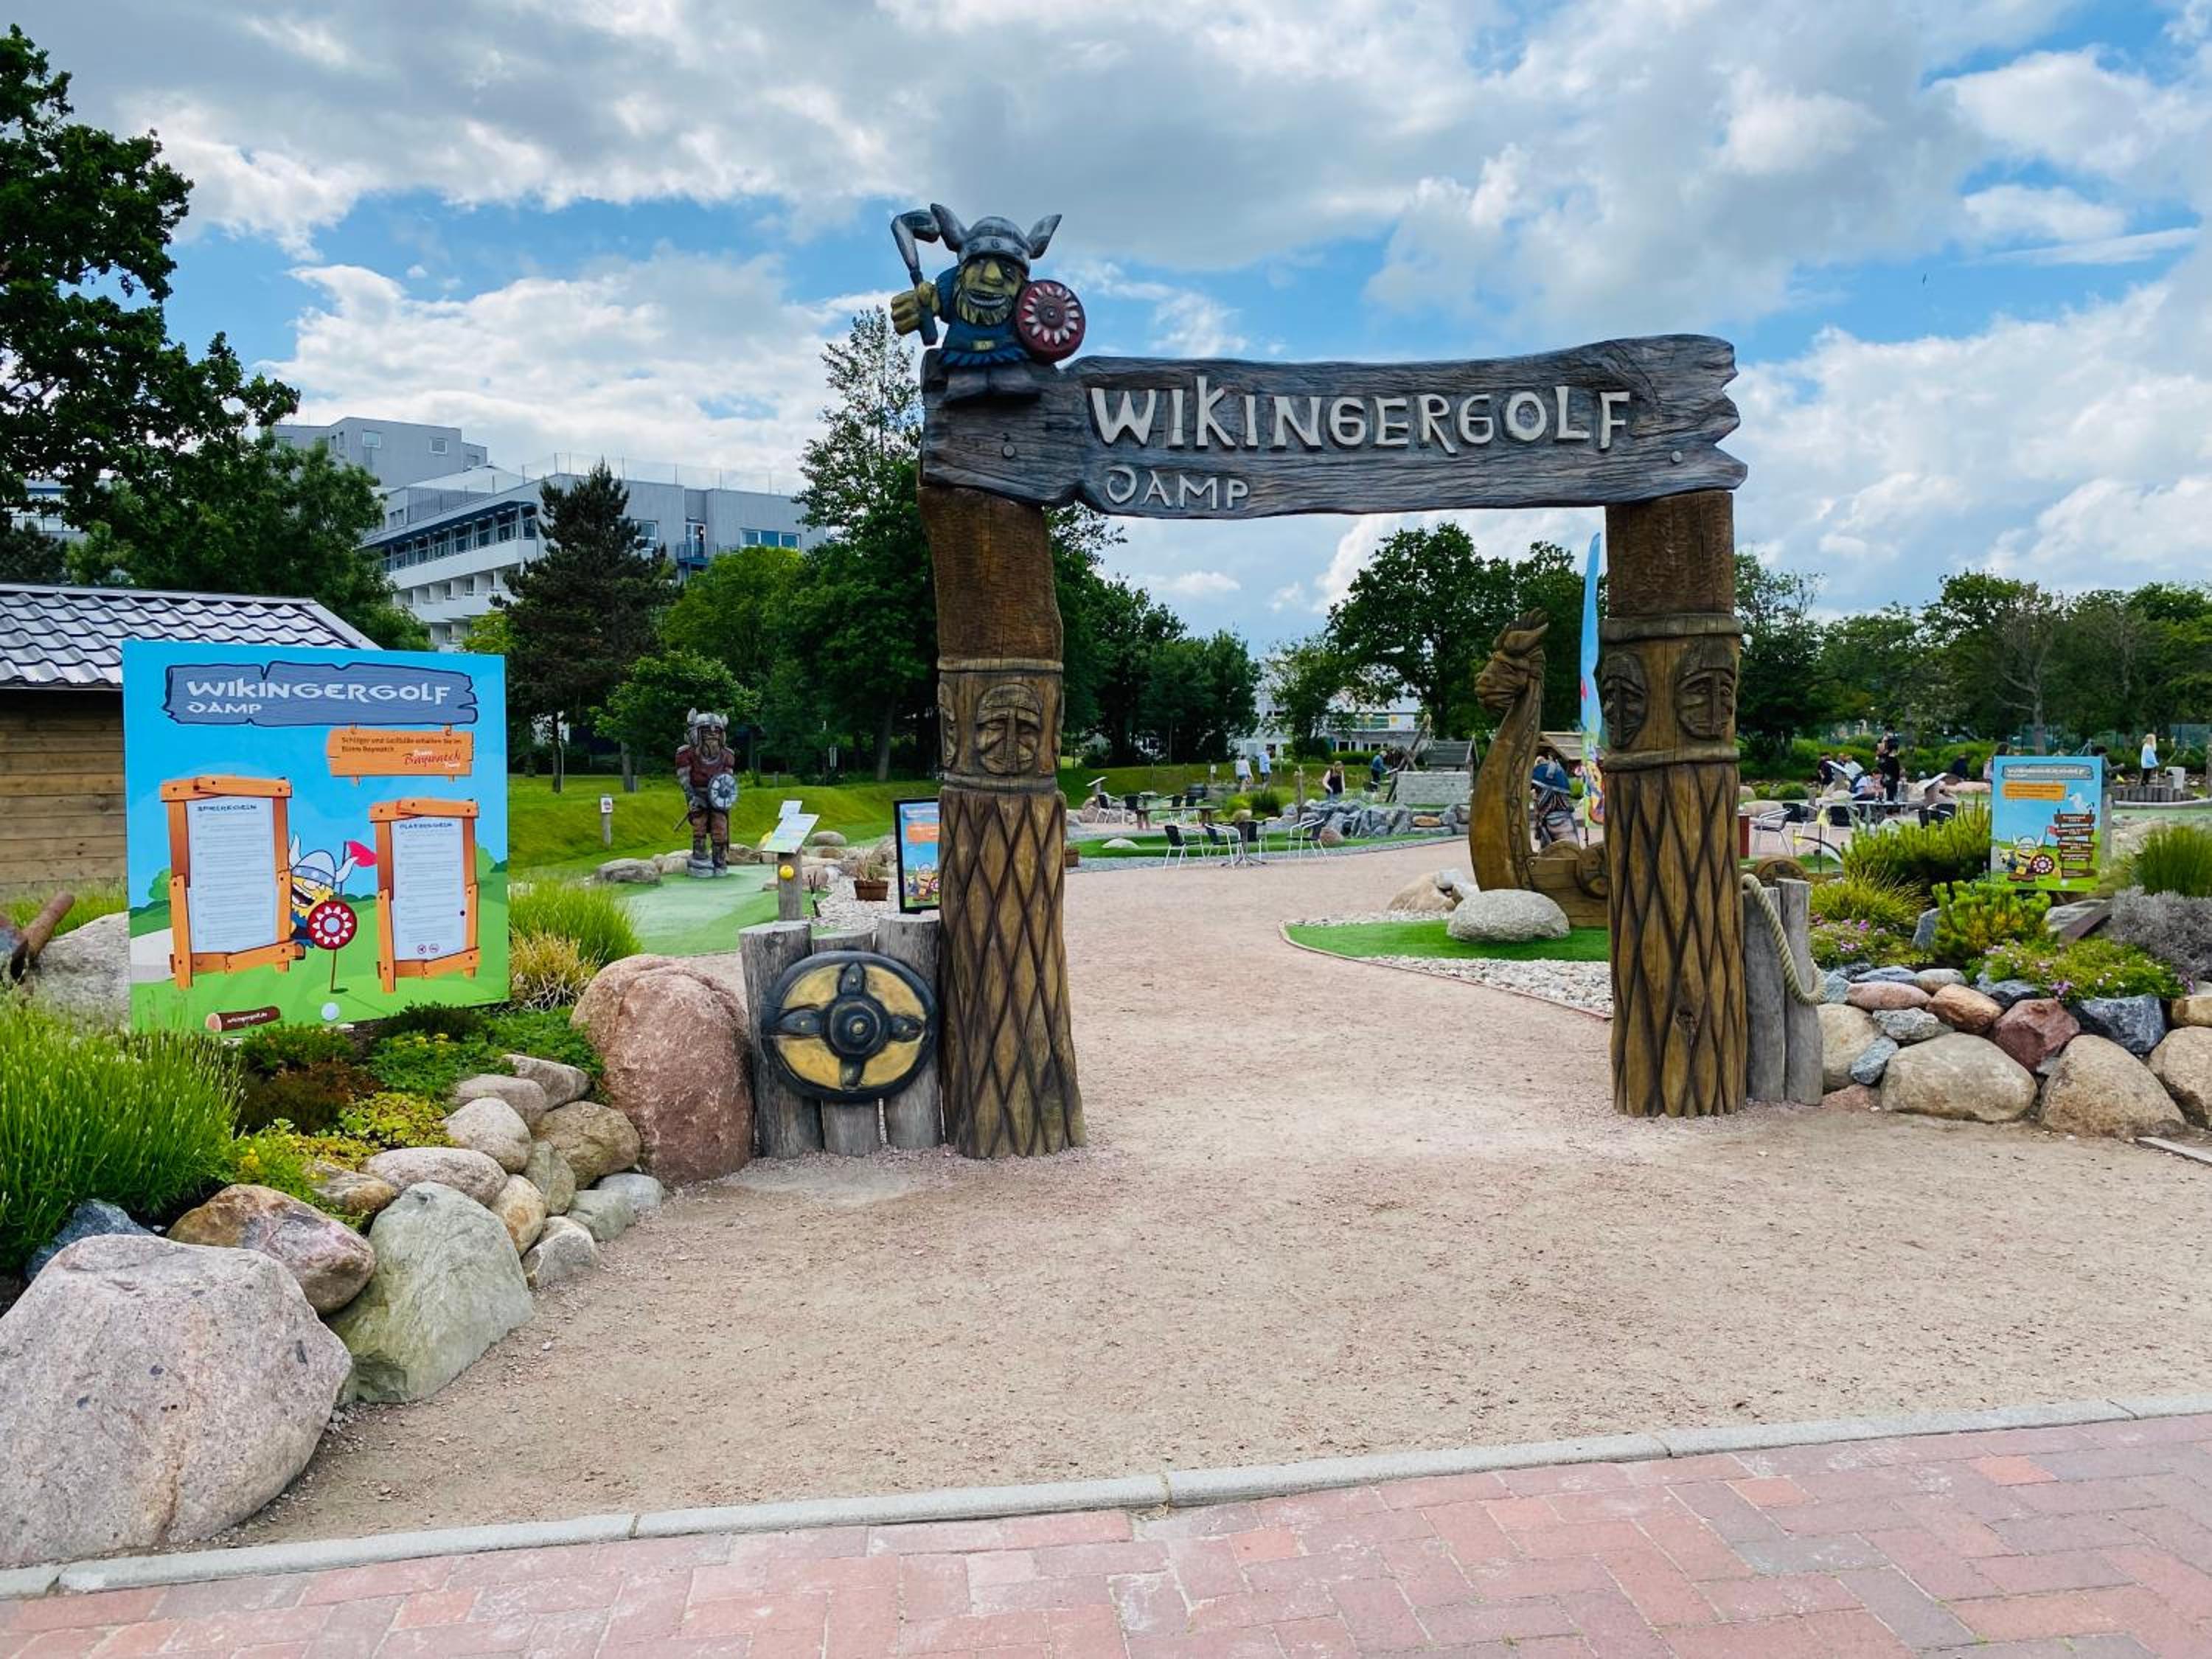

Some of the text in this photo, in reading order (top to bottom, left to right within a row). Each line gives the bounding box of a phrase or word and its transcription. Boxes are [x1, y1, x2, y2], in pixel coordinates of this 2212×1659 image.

[1090, 375, 1631, 454] WIKINGERGOLF
[1105, 466, 1249, 509] DAMP
[187, 678, 451, 705] WIKINGERGOLF
[187, 701, 262, 714] DAMP
